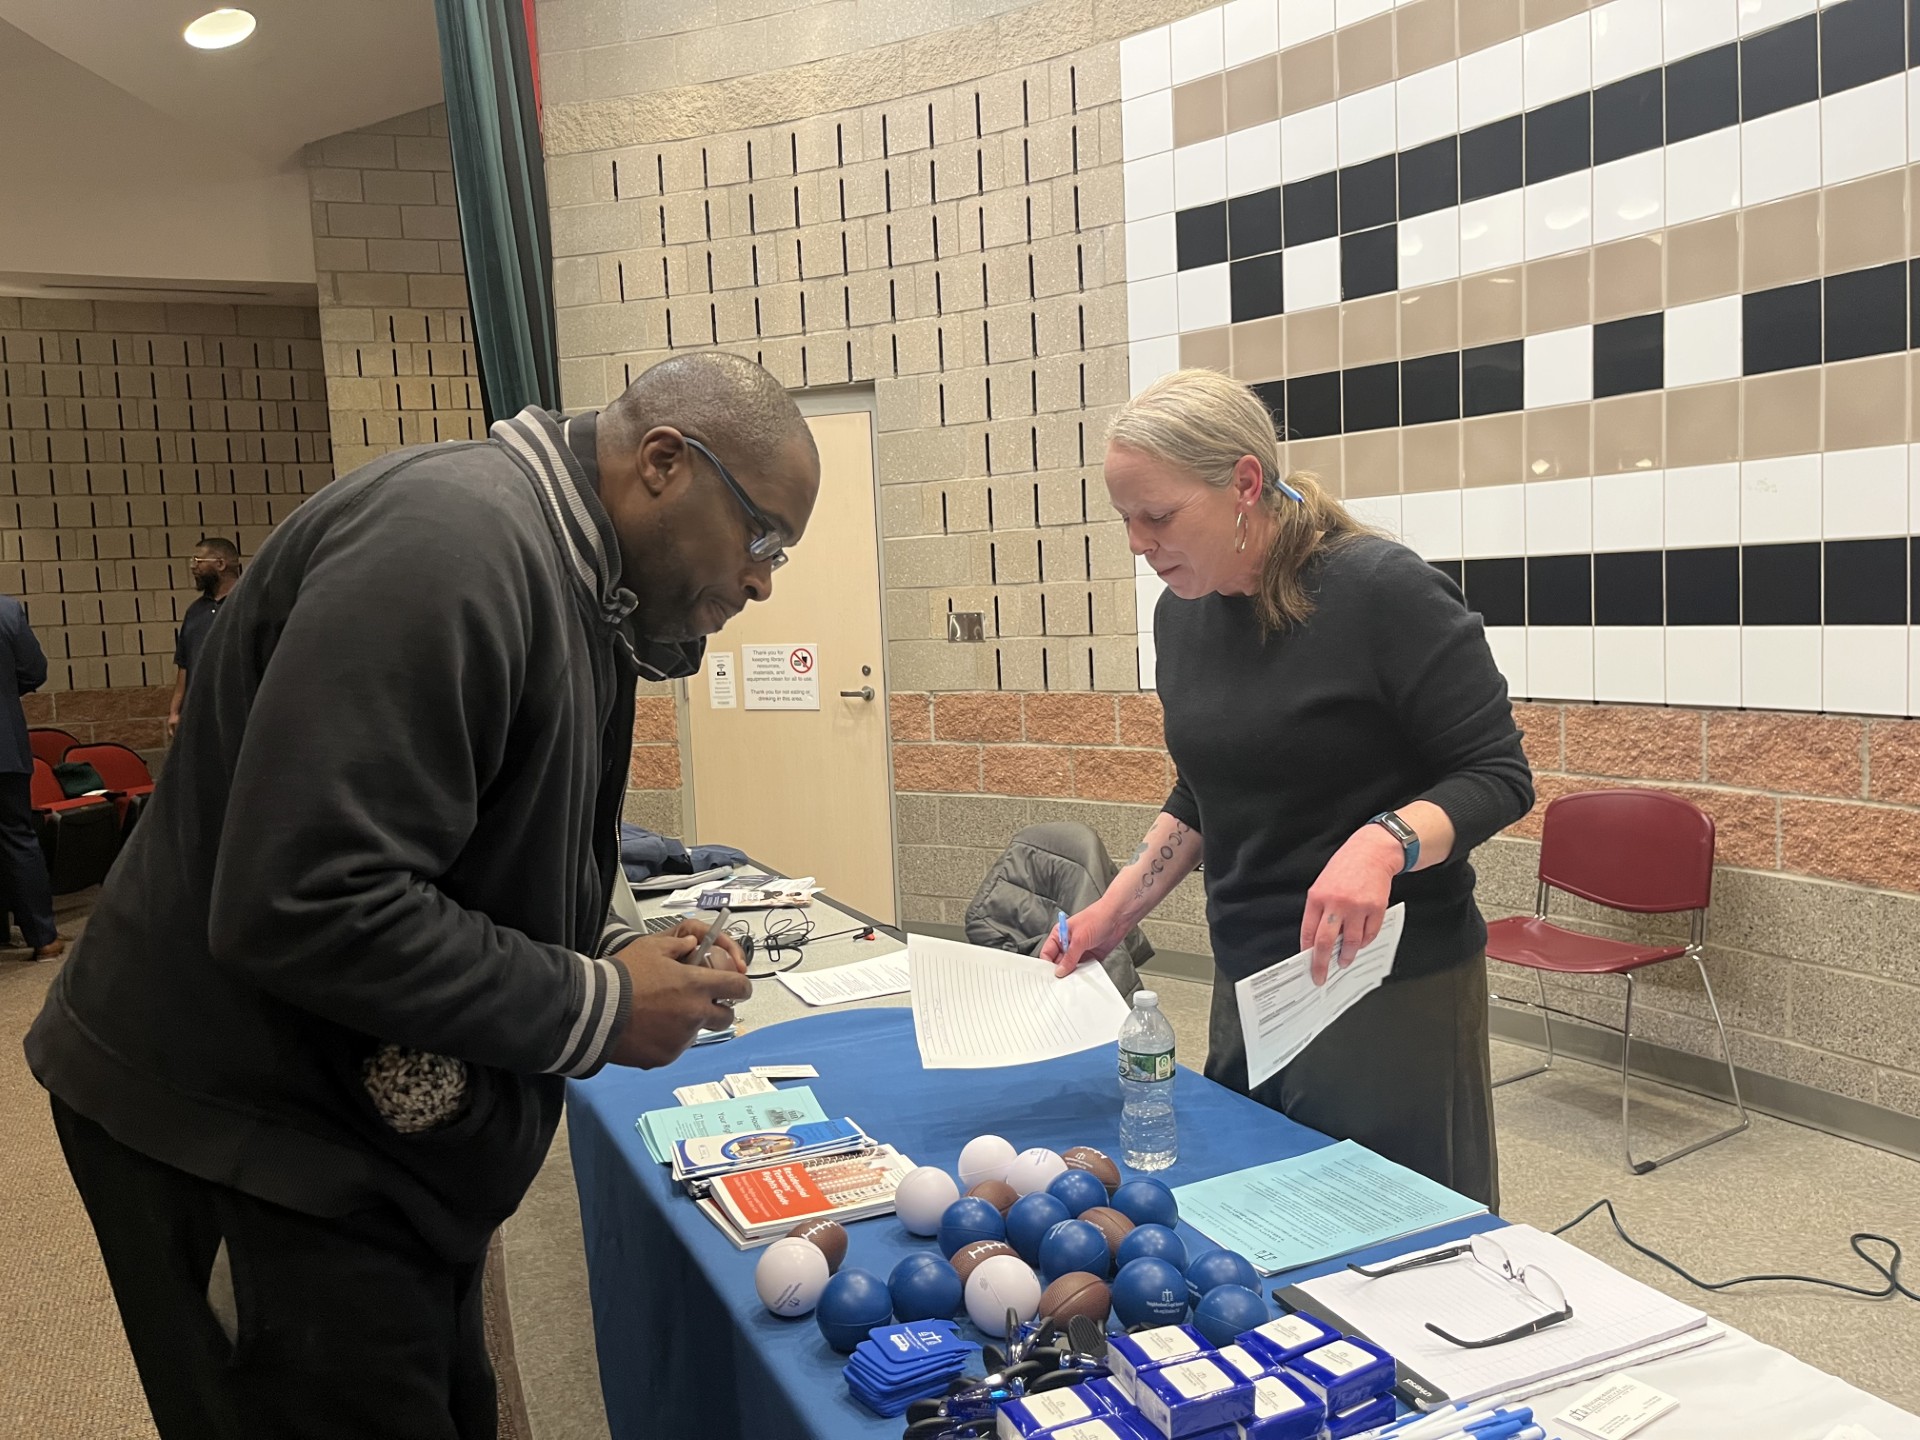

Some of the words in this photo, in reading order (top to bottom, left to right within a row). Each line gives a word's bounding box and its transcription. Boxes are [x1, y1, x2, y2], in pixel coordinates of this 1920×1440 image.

[718, 1112, 726, 1124] Your
[745, 1105, 754, 1115] Fair
[761, 1171, 778, 1189] Rights
[773, 1189, 790, 1206] Guide
[783, 1166, 811, 1198] Residential
